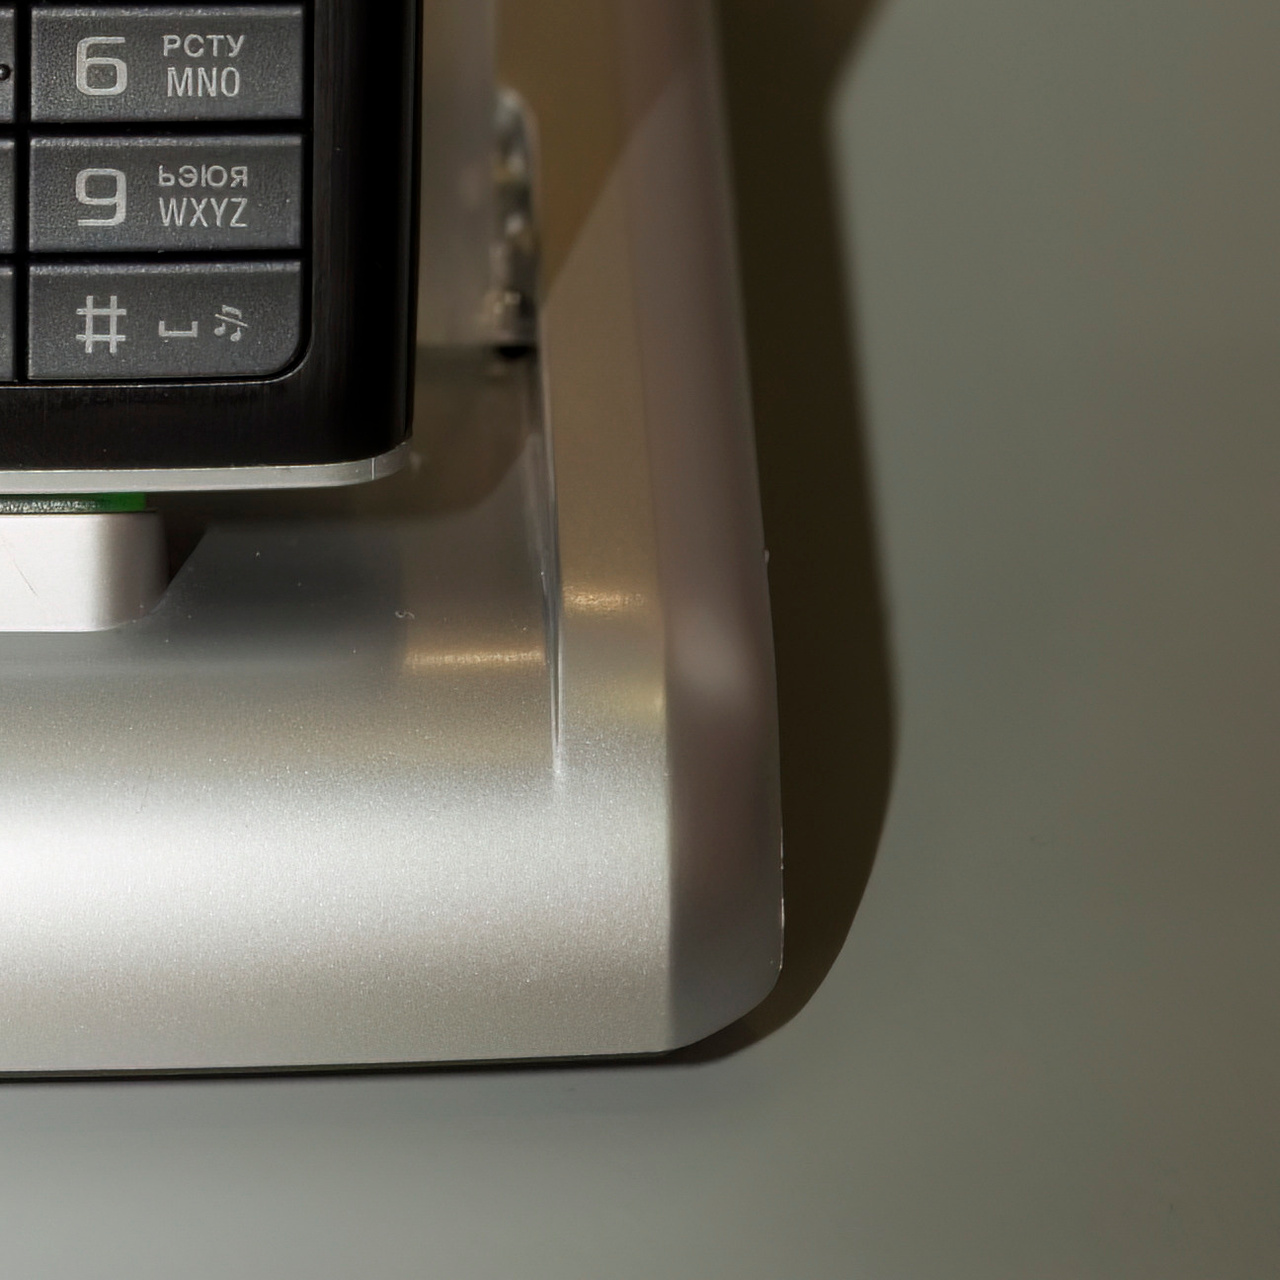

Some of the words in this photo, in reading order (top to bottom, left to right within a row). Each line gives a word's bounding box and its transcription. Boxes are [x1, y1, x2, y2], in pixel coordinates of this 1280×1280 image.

[162, 34, 245, 57] РСТУ
[74, 35, 128, 96] 6
[166, 66, 242, 98] MNO
[156, 165, 250, 188] ЬЭЮЯ
[74, 167, 127, 227] 9
[158, 196, 249, 228] WXYZ
